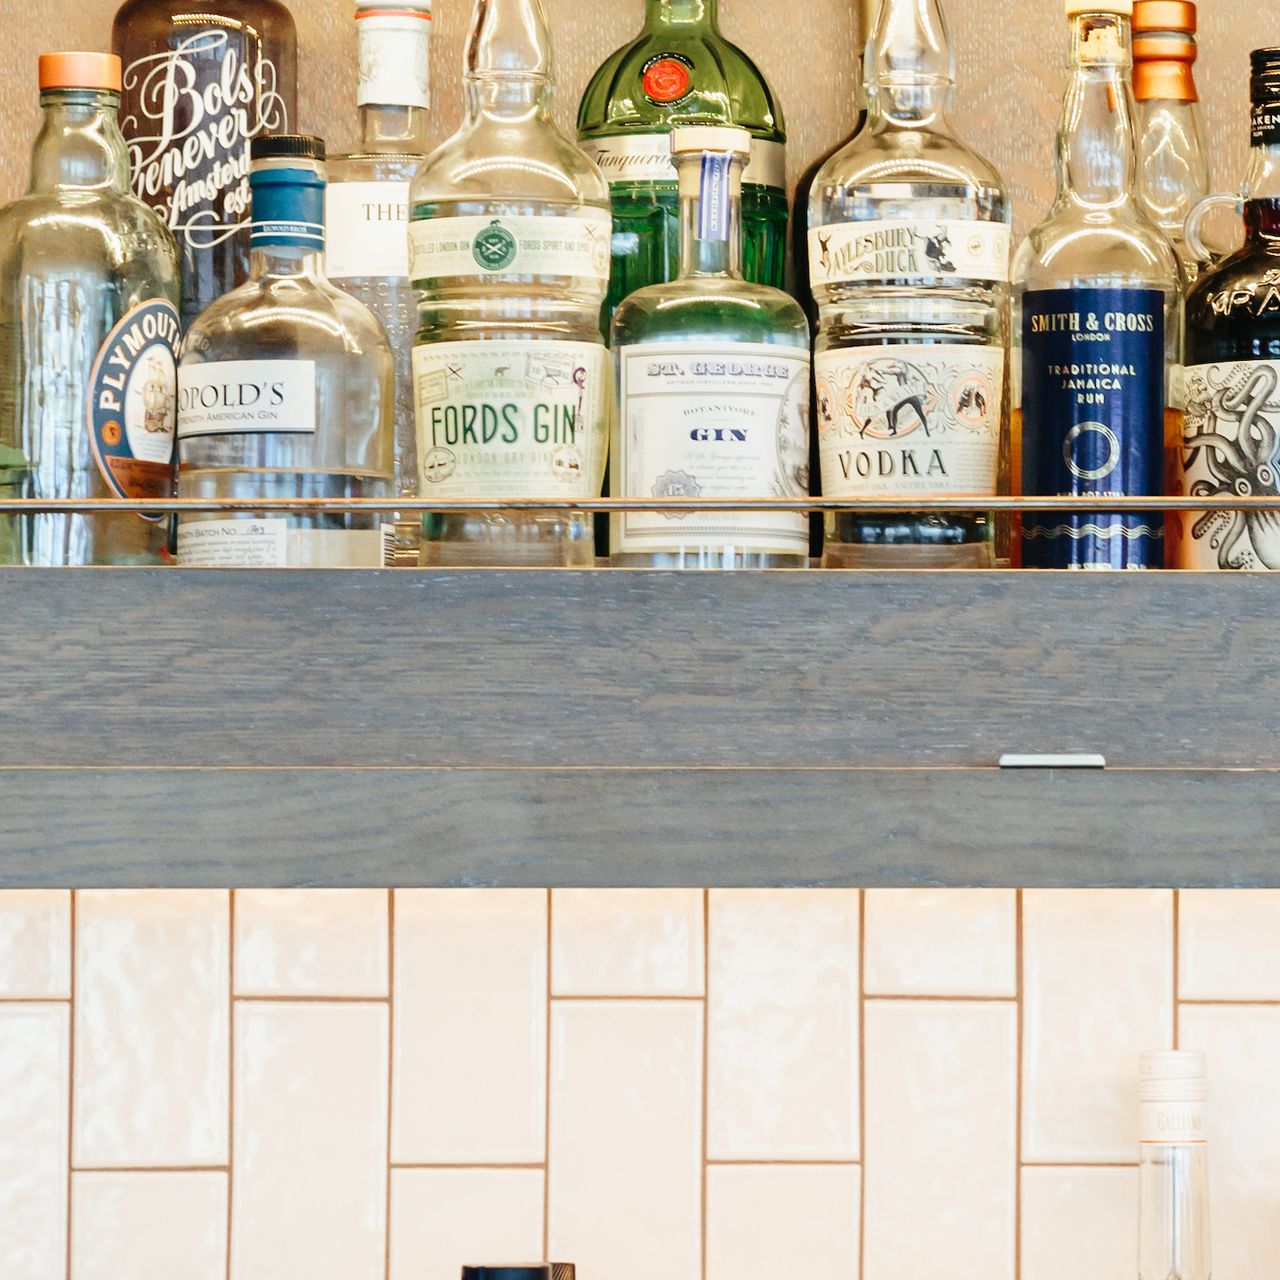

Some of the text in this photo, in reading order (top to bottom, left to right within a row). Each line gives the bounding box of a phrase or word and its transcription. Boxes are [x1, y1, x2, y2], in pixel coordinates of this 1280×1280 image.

[1252, 114, 1280, 126] AKEN
[165, 140, 251, 228] Amsterd
[361, 203, 408, 221] THE
[833, 227, 918, 277] AYLESBURY
[874, 251, 920, 272] DUCK
[1031, 312, 1154, 333] SMITH & CROSS
[1071, 333, 1111, 342] LONDON
[689, 360, 790, 379] GEORGE
[1047, 364, 1136, 376] TRADITIONAL
[1061, 378, 1122, 391] JAMAICA
[177, 381, 285, 414] OPOLD'S
[1076, 393, 1105, 405] RUM
[205, 411, 254, 422] AMERICAN
[257, 409, 278, 420] GIN
[431, 403, 577, 446] FORDS GIN
[689, 428, 749, 442] GIN
[838, 449, 949, 478] VODKA
[194, 527, 220, 538] BATCH
